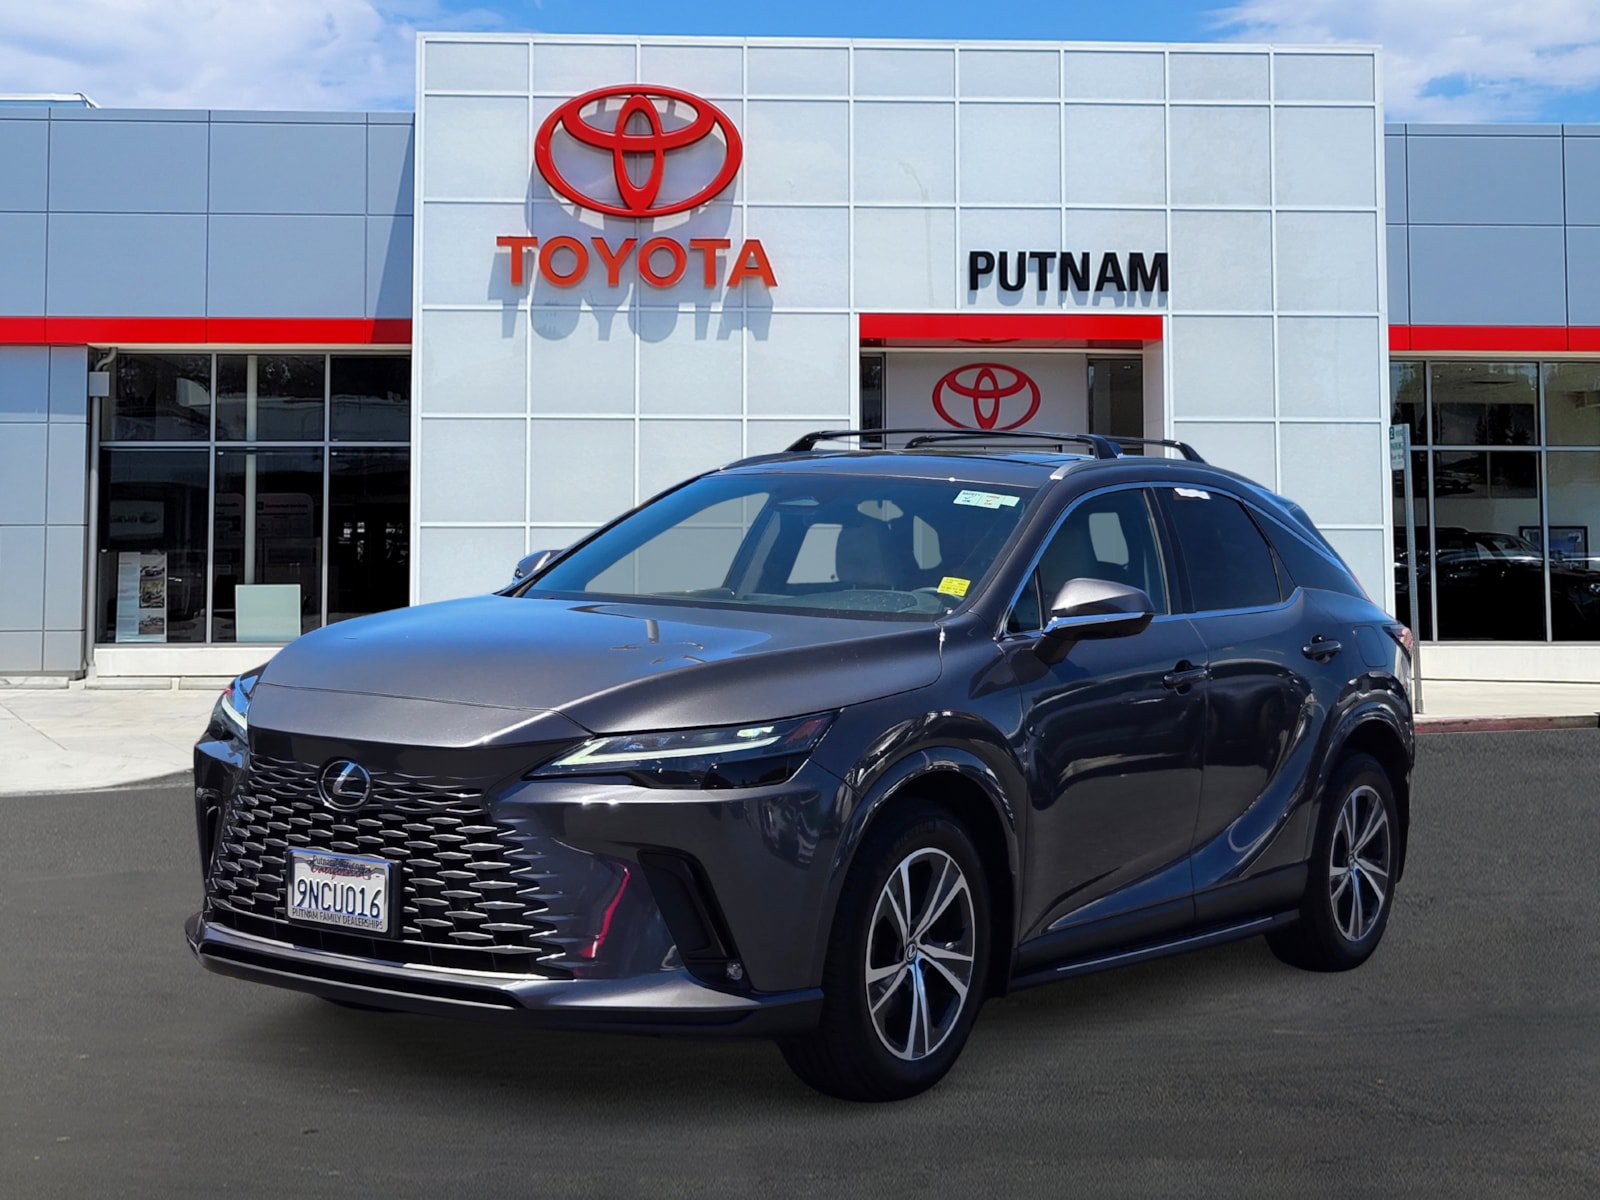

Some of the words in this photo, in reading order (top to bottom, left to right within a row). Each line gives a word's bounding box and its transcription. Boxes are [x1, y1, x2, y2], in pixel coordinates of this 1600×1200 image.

[496, 236, 778, 288] TOYOTA
[969, 251, 1169, 292] PUTNAM
[292, 908, 318, 920] PUTNAM
[320, 912, 342, 923] FAMILY
[343, 916, 383, 929] DEALERSHIPS
[296, 879, 382, 919] 9NCU016
